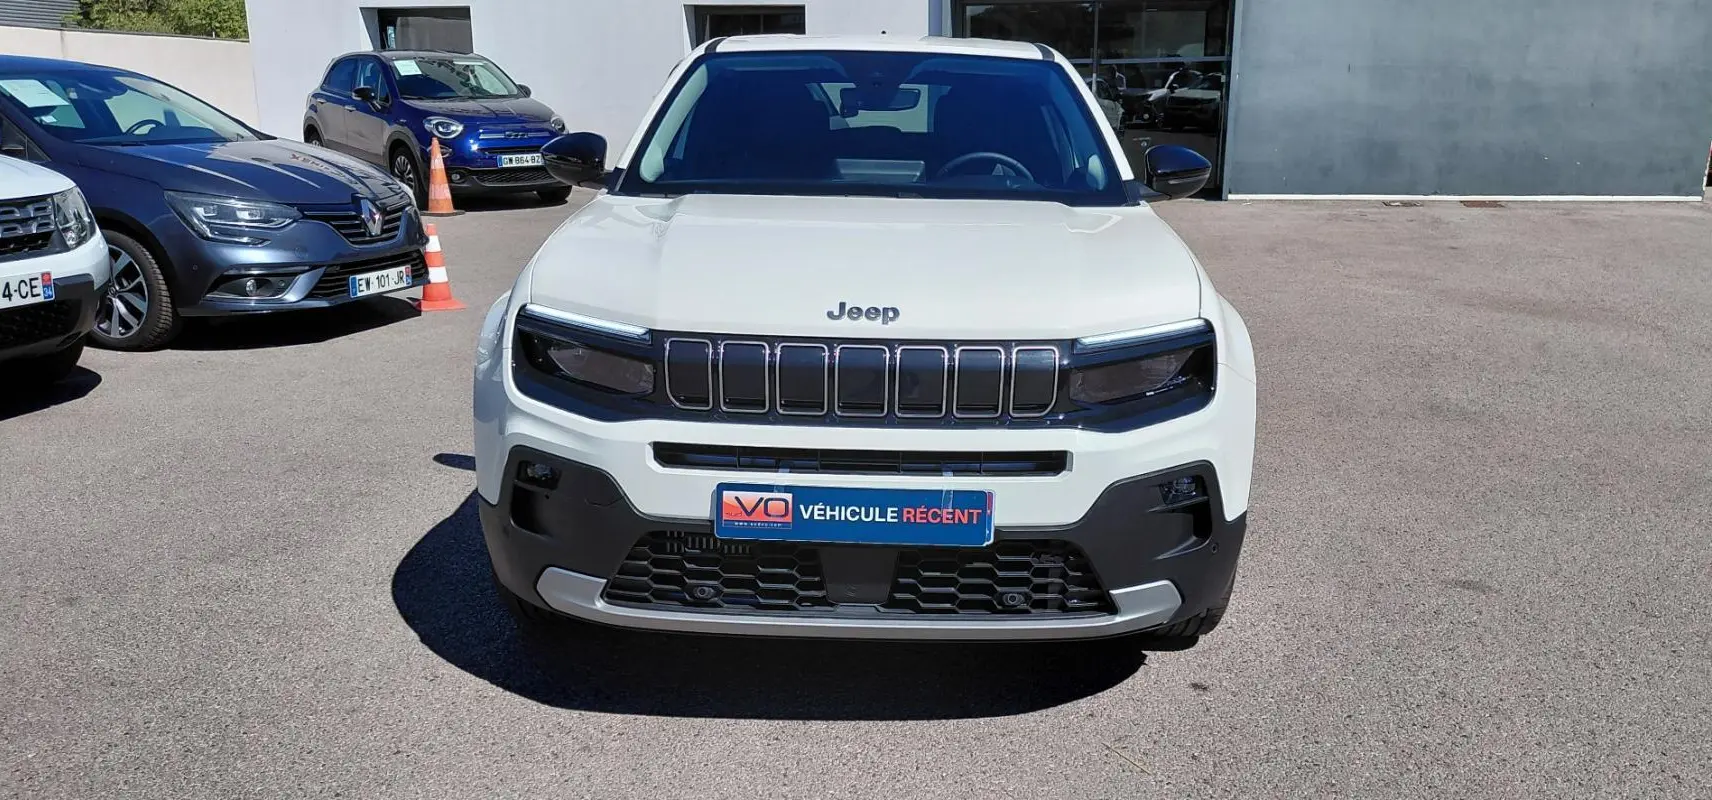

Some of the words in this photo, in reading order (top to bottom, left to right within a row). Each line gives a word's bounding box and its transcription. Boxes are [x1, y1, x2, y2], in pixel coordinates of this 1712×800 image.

[826, 301, 900, 326] Jeep
[734, 495, 789, 518] VO
[800, 502, 899, 523] VÉHICULE
[902, 505, 983, 525] RÉCENT
